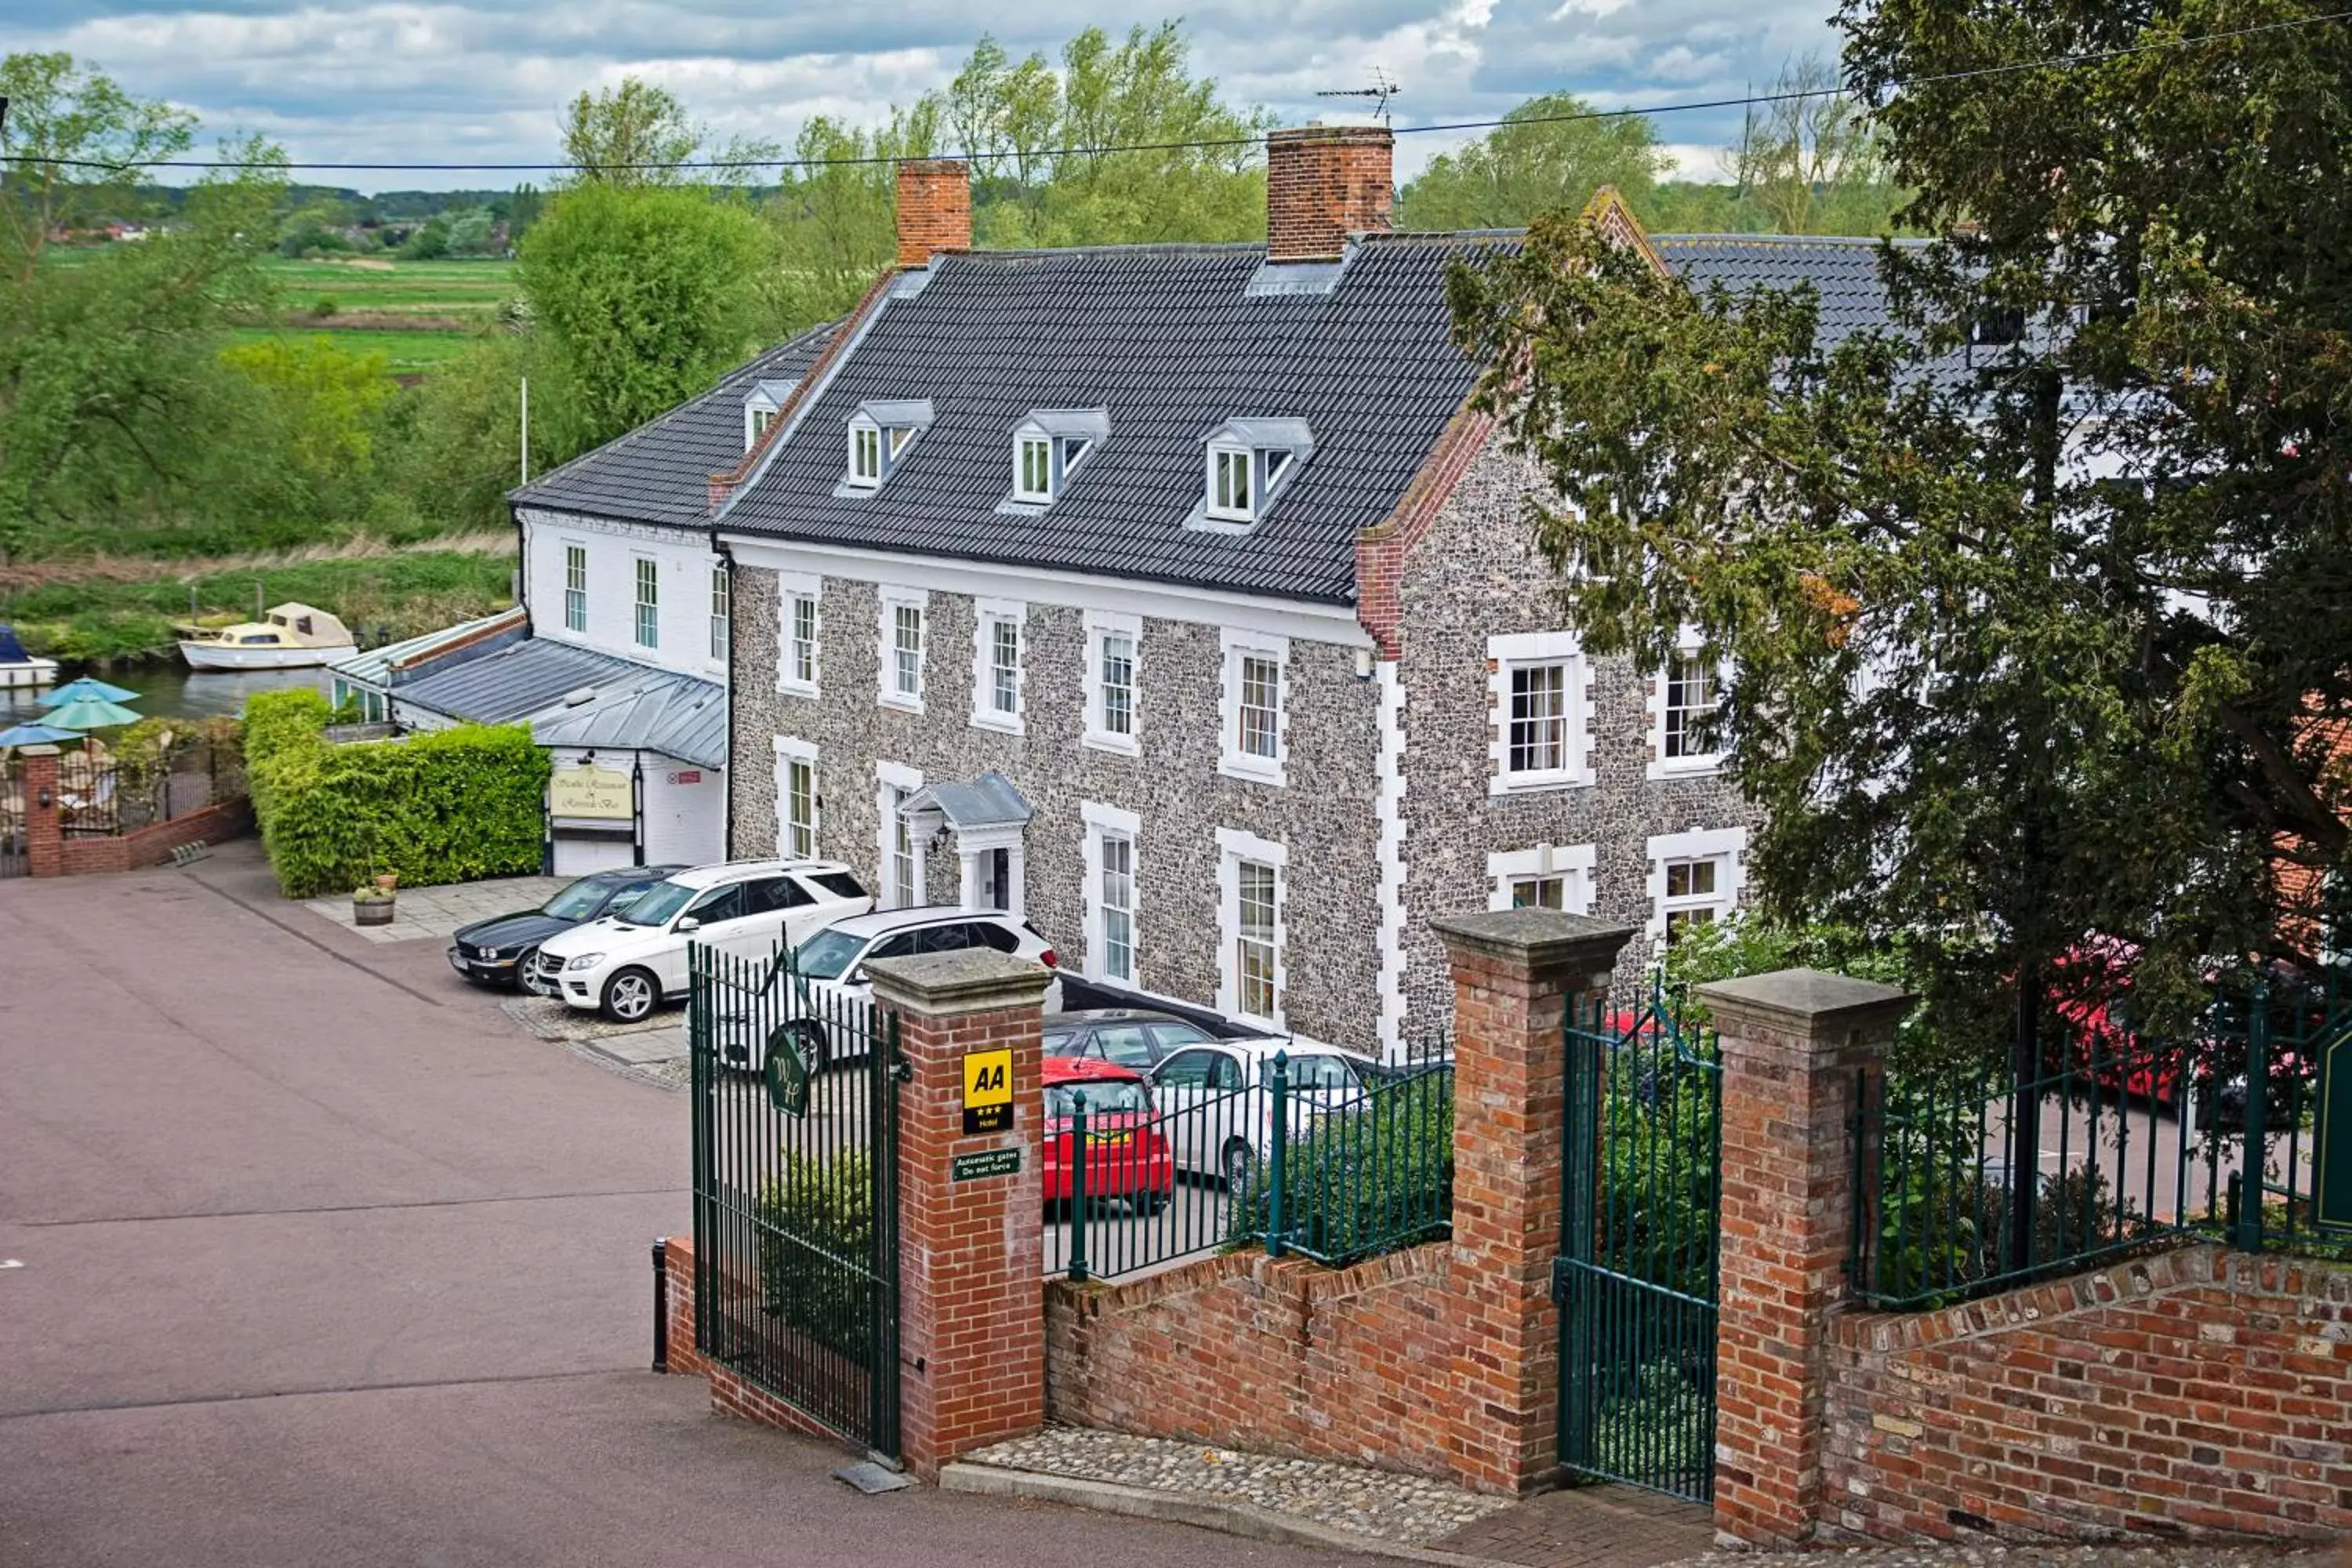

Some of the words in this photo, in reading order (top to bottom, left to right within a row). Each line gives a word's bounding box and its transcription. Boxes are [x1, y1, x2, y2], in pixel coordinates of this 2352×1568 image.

[973, 1065, 1004, 1093] AA
[978, 1118, 998, 1129] Hotel
[956, 1154, 995, 1167] Automatic
[997, 1152, 1017, 1162] gates
[976, 1165, 989, 1174] not
[991, 1163, 1011, 1171] force
